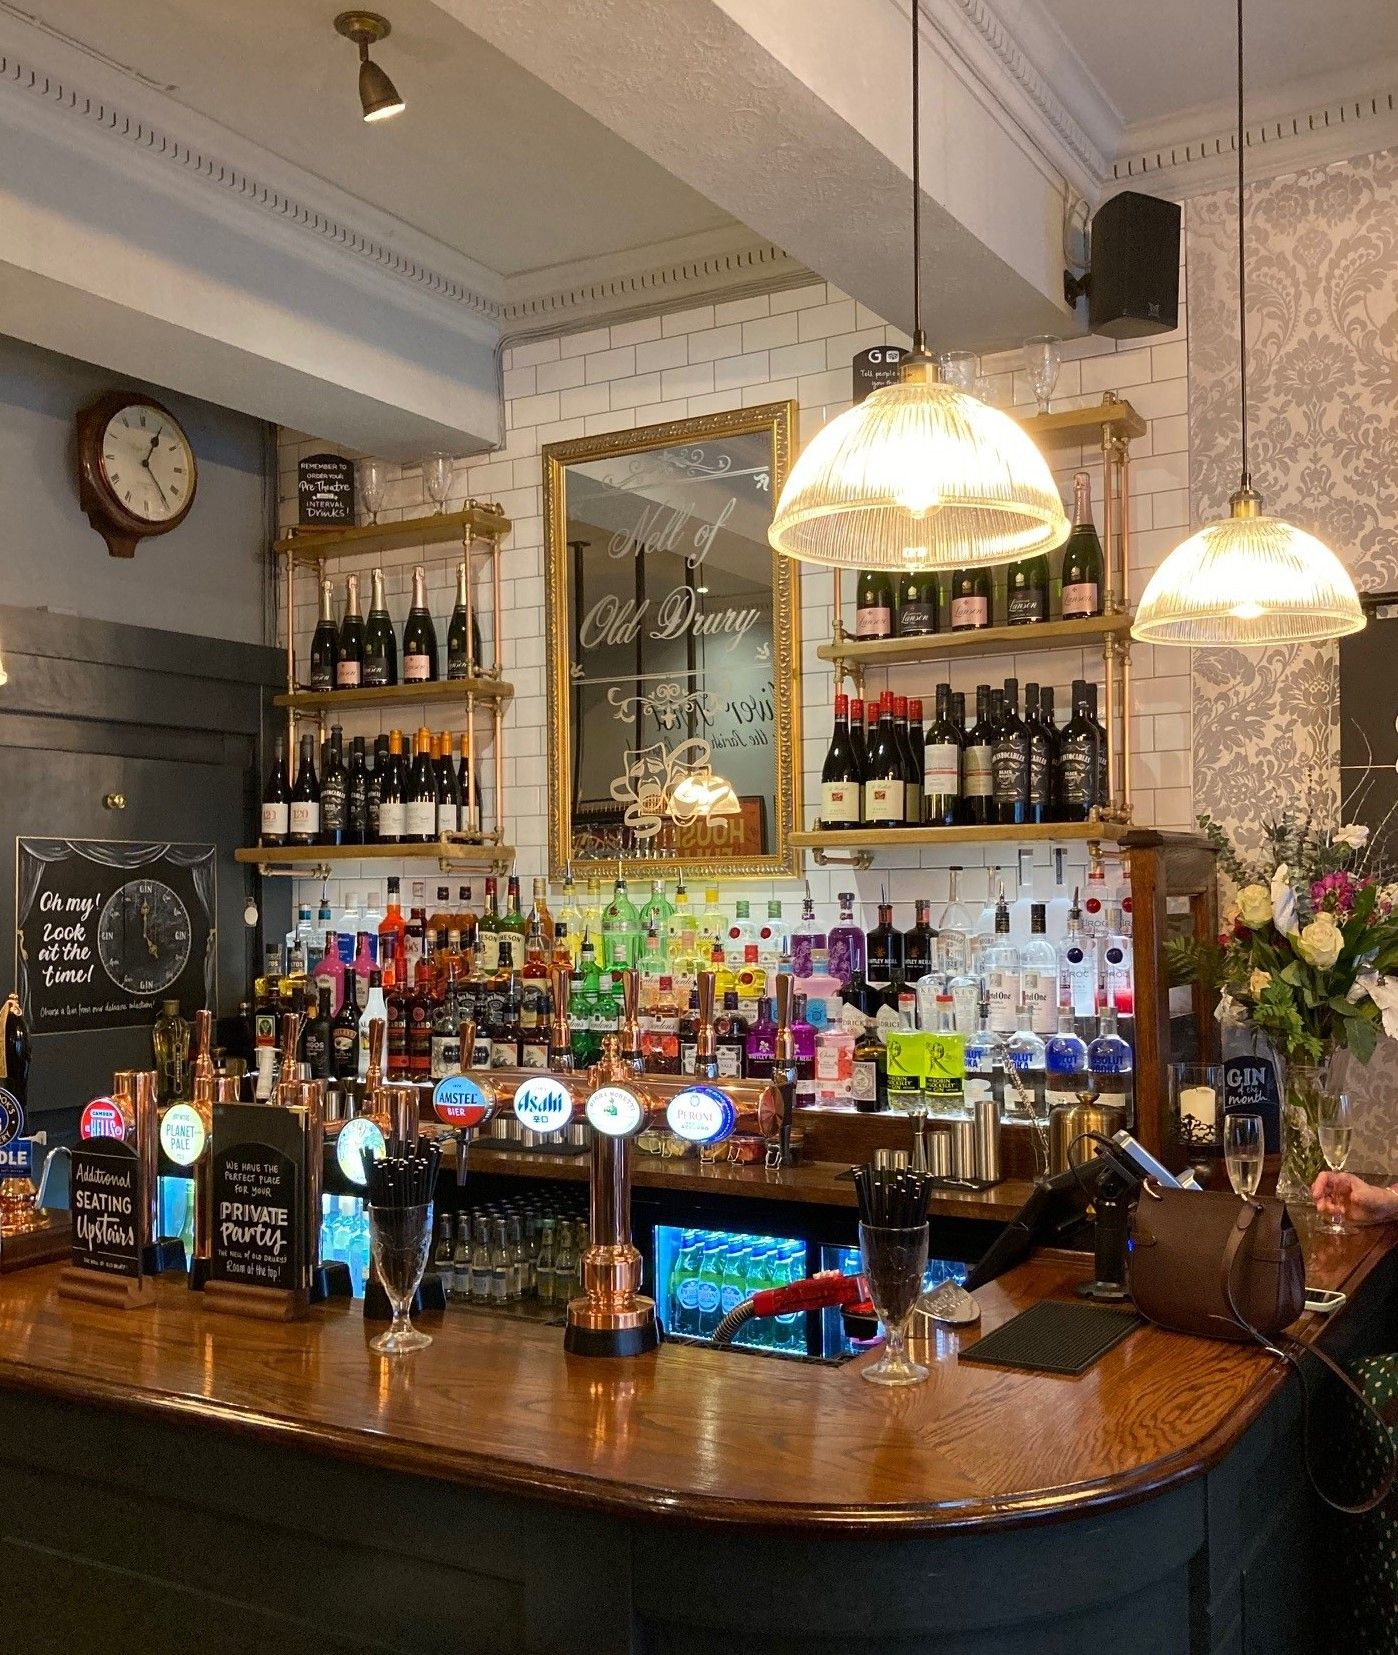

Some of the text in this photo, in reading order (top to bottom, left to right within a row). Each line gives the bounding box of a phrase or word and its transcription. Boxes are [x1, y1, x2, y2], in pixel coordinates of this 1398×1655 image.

[876, 370, 896, 378] people
[299, 480, 351, 492] Pre Theatre
[306, 507, 349, 518] Drinks!
[608, 497, 737, 569] Nell of
[579, 585, 760, 651] Old Drury
[39, 891, 101, 922] Oh my!
[43, 923, 86, 942] Look
[101, 931, 114, 940] GIN
[175, 931, 187, 940] GIN
[39, 943, 91, 961] at the
[42, 964, 95, 988] time!
[140, 981, 154, 990] GIN
[1227, 1067, 1266, 1088] GIN
[440, 1092, 478, 1104] AMSTEL
[518, 1090, 562, 1112] Asahi
[1229, 1090, 1268, 1105] month
[447, 1108, 466, 1117] BIER
[678, 1109, 713, 1121] PERONI
[90, 1119, 116, 1138] HELLS
[166, 1124, 195, 1138] PLANET
[171, 1137, 190, 1150] PALE
[226, 1161, 279, 1174] WE HAVE THE
[76, 1163, 131, 1189] Additional
[225, 1171, 281, 1185] PERFECT PLACE
[235, 1184, 272, 1197] FOR YOUR
[76, 1190, 132, 1214] SEATING
[220, 1201, 288, 1226] PRIVATE
[77, 1213, 135, 1252] Upstairs
[220, 1222, 288, 1256] Party
[218, 1249, 228, 1257] THE
[230, 1251, 243, 1259] NELL
[252, 1253, 262, 1261] OLD
[226, 1260, 281, 1283] Room at the top!
